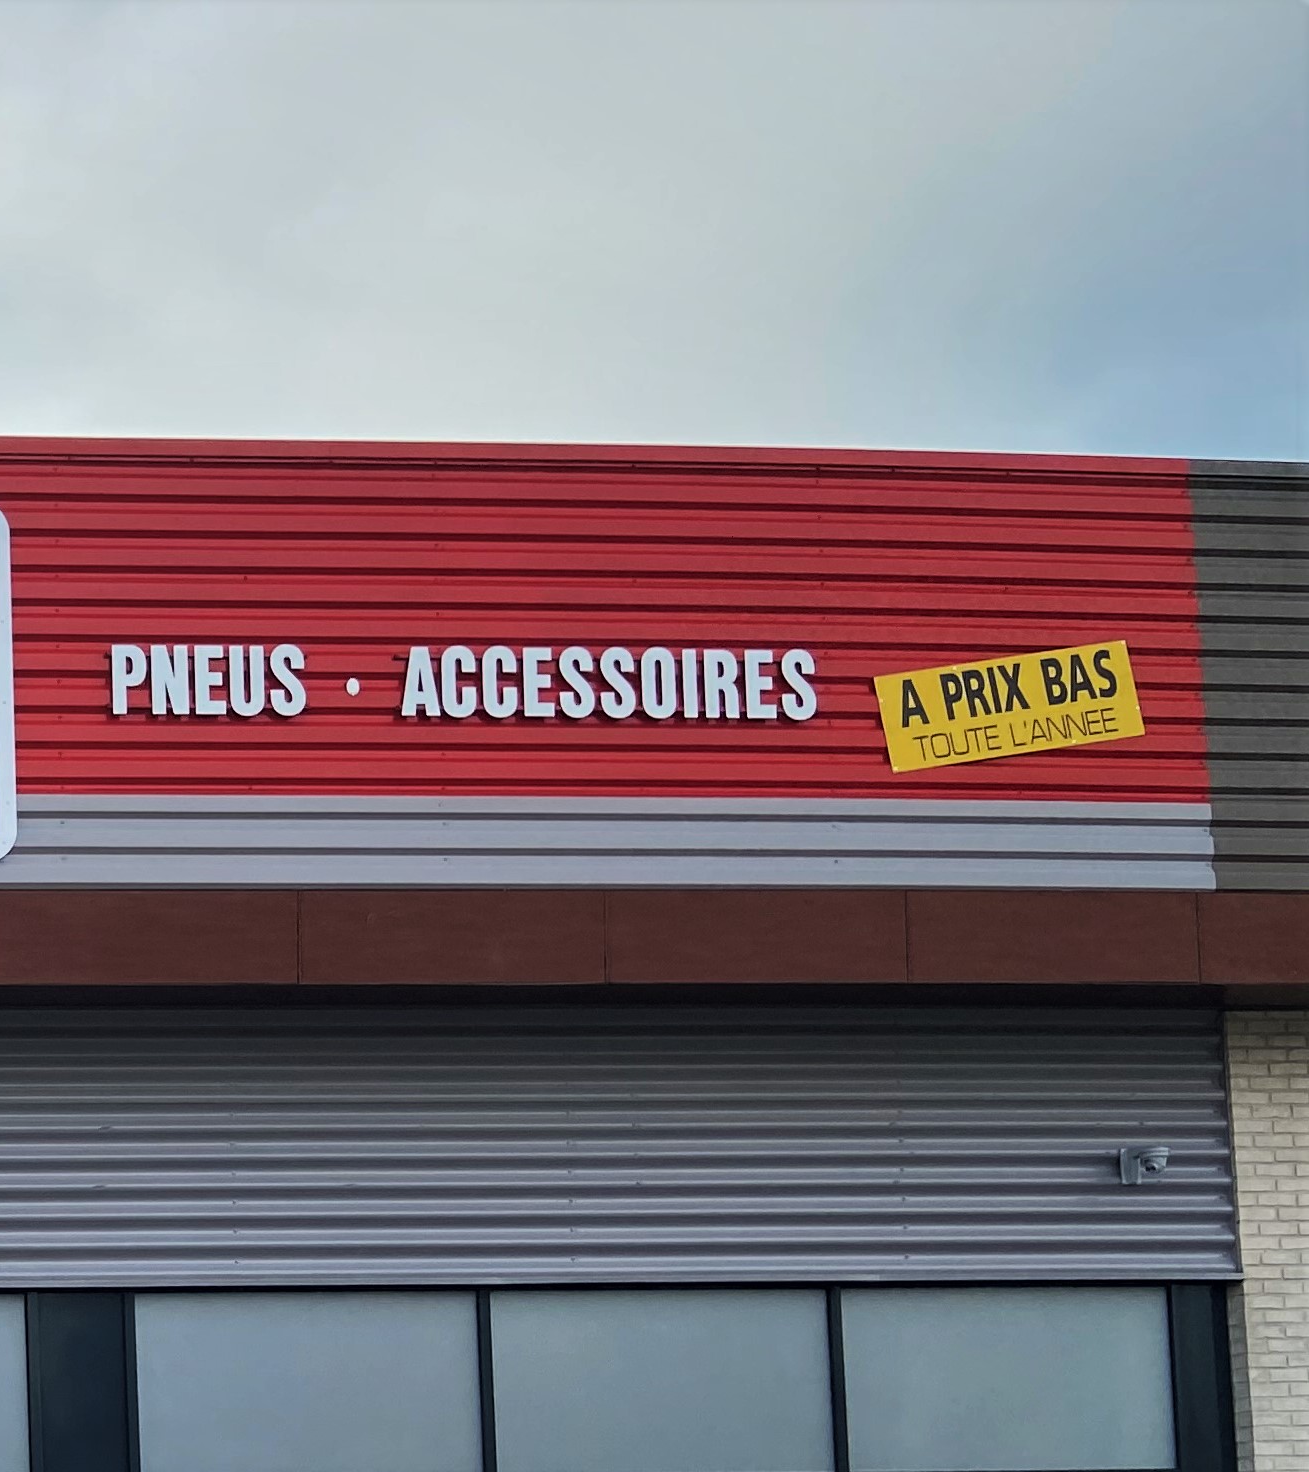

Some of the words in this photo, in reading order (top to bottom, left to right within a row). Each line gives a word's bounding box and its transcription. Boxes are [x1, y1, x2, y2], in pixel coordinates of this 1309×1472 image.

[111, 644, 307, 717] PNEUS
[400, 646, 818, 722] ACCESSOIRES
[902, 679, 930, 728] A
[939, 663, 1031, 721] PRIX
[1040, 650, 1118, 706] BAS
[913, 724, 1002, 761] TOUTE
[1009, 708, 1120, 748] L'ANNEE
